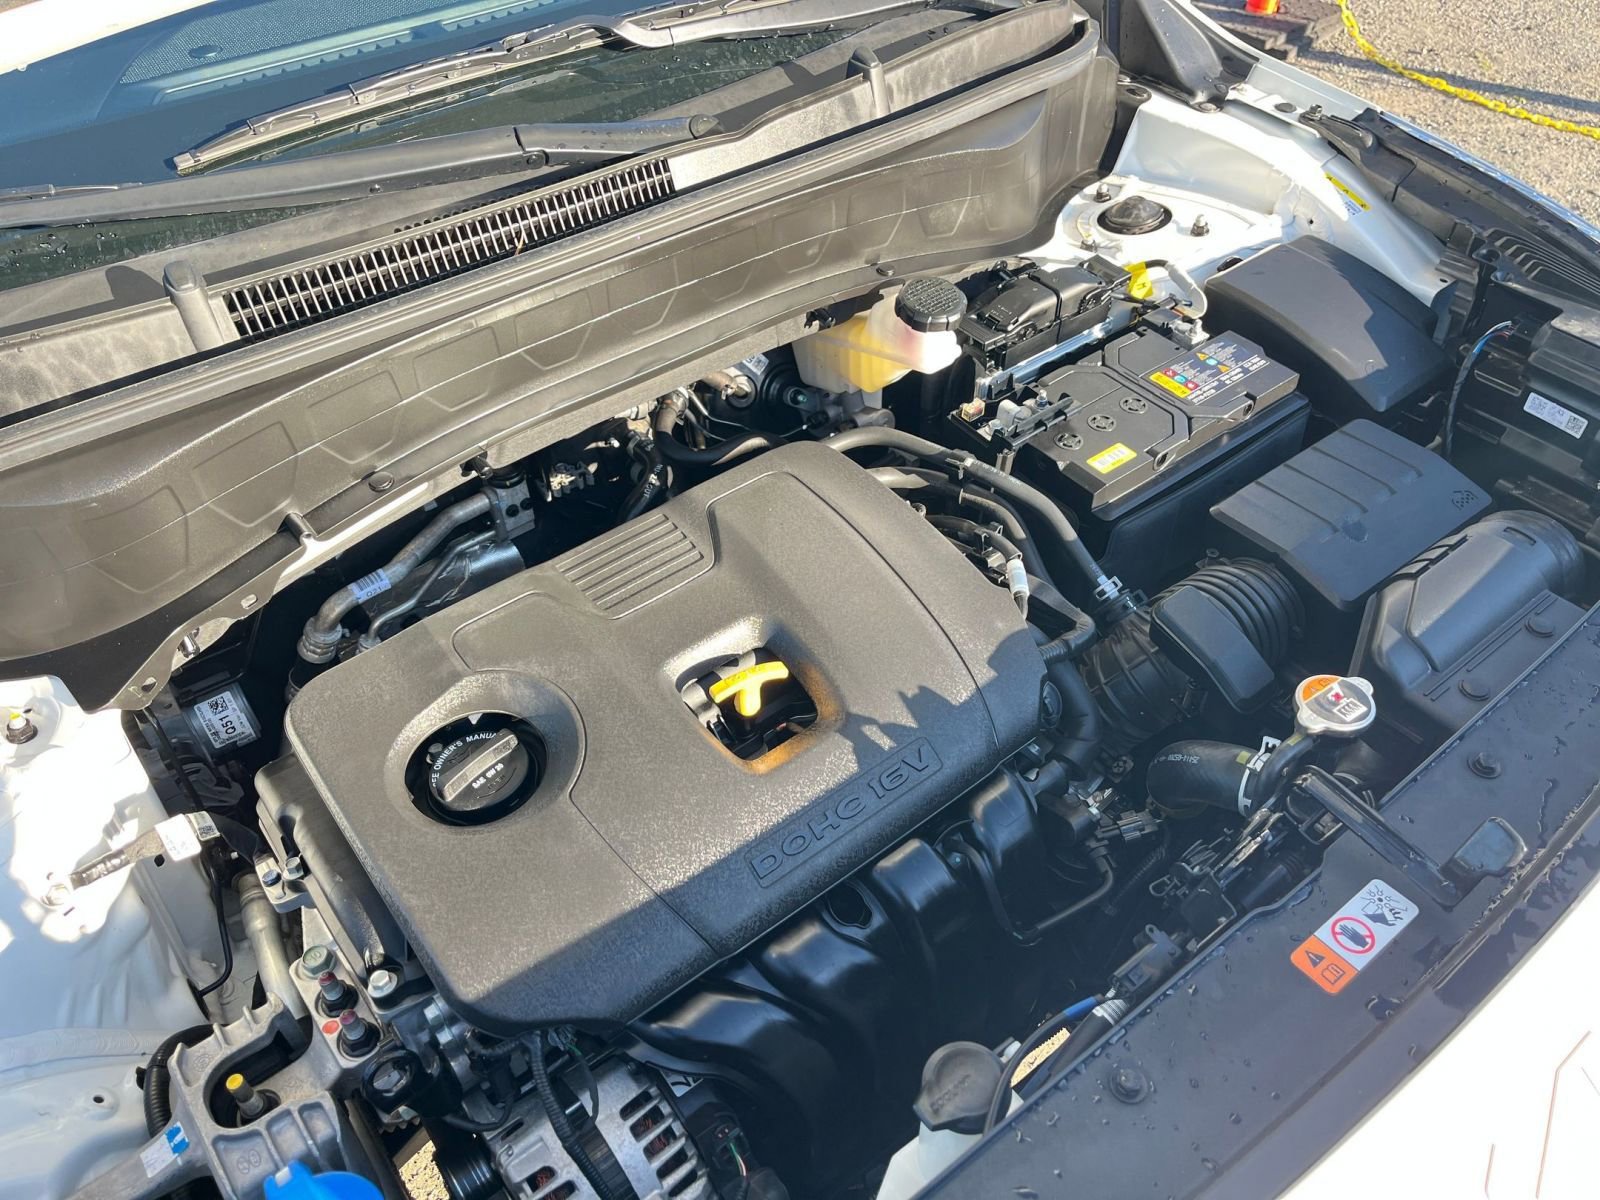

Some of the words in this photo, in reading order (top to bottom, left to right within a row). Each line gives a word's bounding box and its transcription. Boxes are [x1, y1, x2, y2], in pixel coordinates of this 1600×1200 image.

[218, 714, 237, 735] Q51
[433, 740, 463, 770] OWNER'S
[472, 777, 486, 788] SAE
[750, 797, 867, 879] DOHC
[868, 744, 930, 799] 16V
